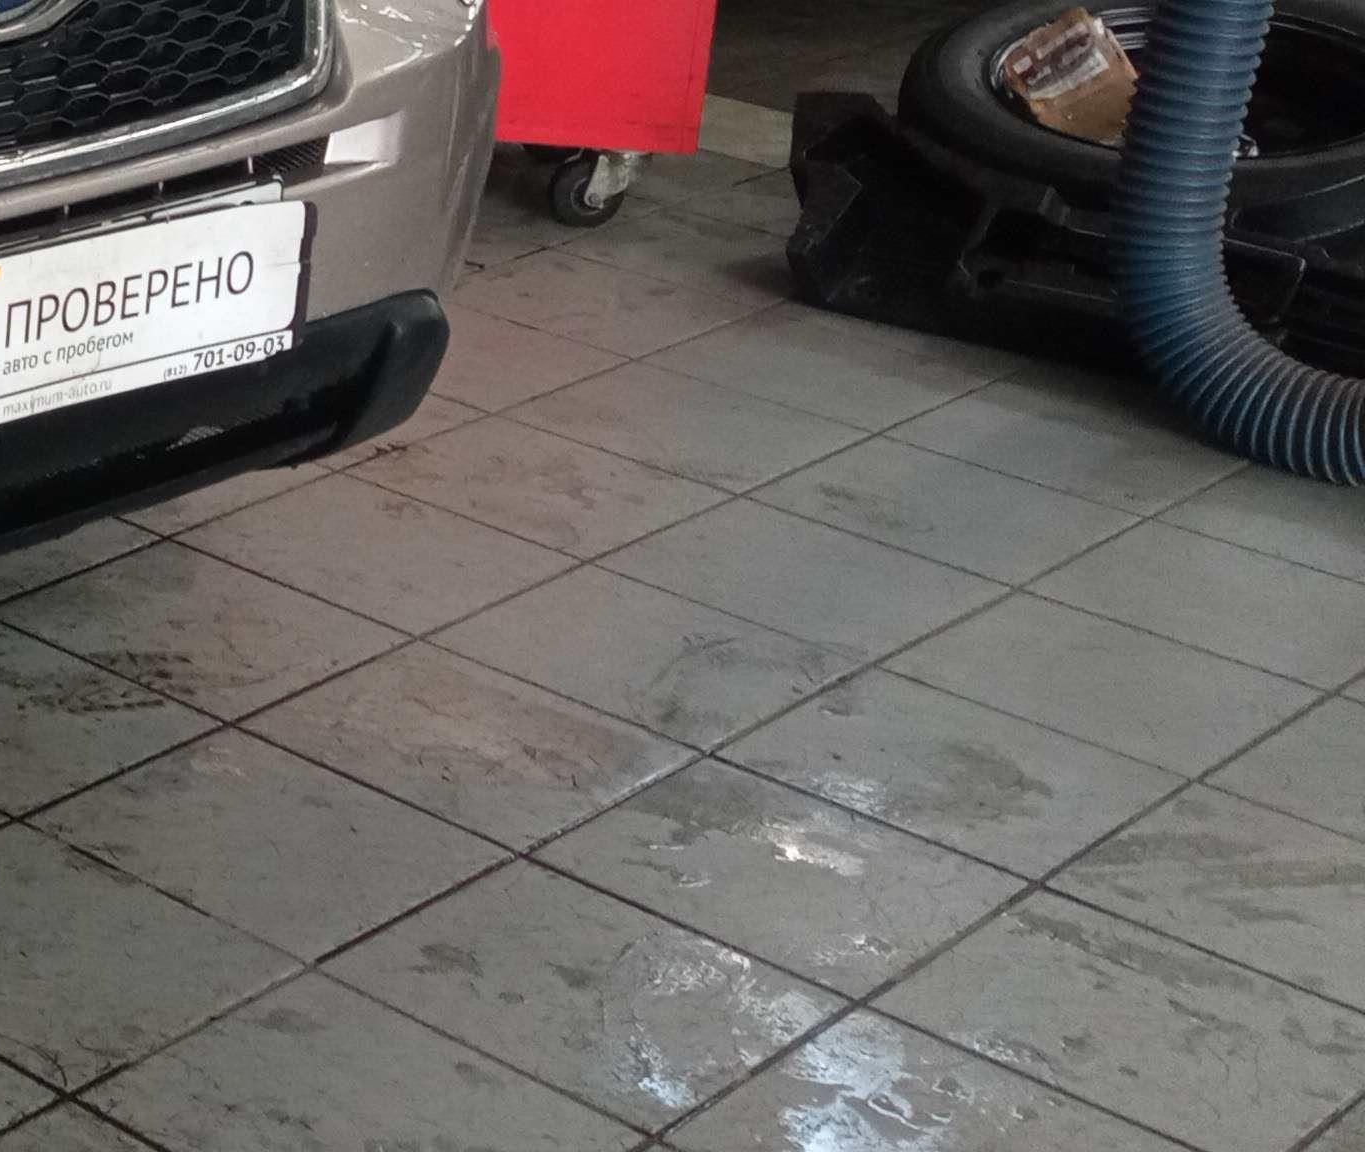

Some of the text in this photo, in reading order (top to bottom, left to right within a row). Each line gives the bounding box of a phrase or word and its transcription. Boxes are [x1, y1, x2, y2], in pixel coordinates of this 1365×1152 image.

[5, 251, 254, 348] ПРОВЕРЕНО
[3, 332, 134, 375] авто с пробегом
[193, 335, 286, 372] 701-09-03
